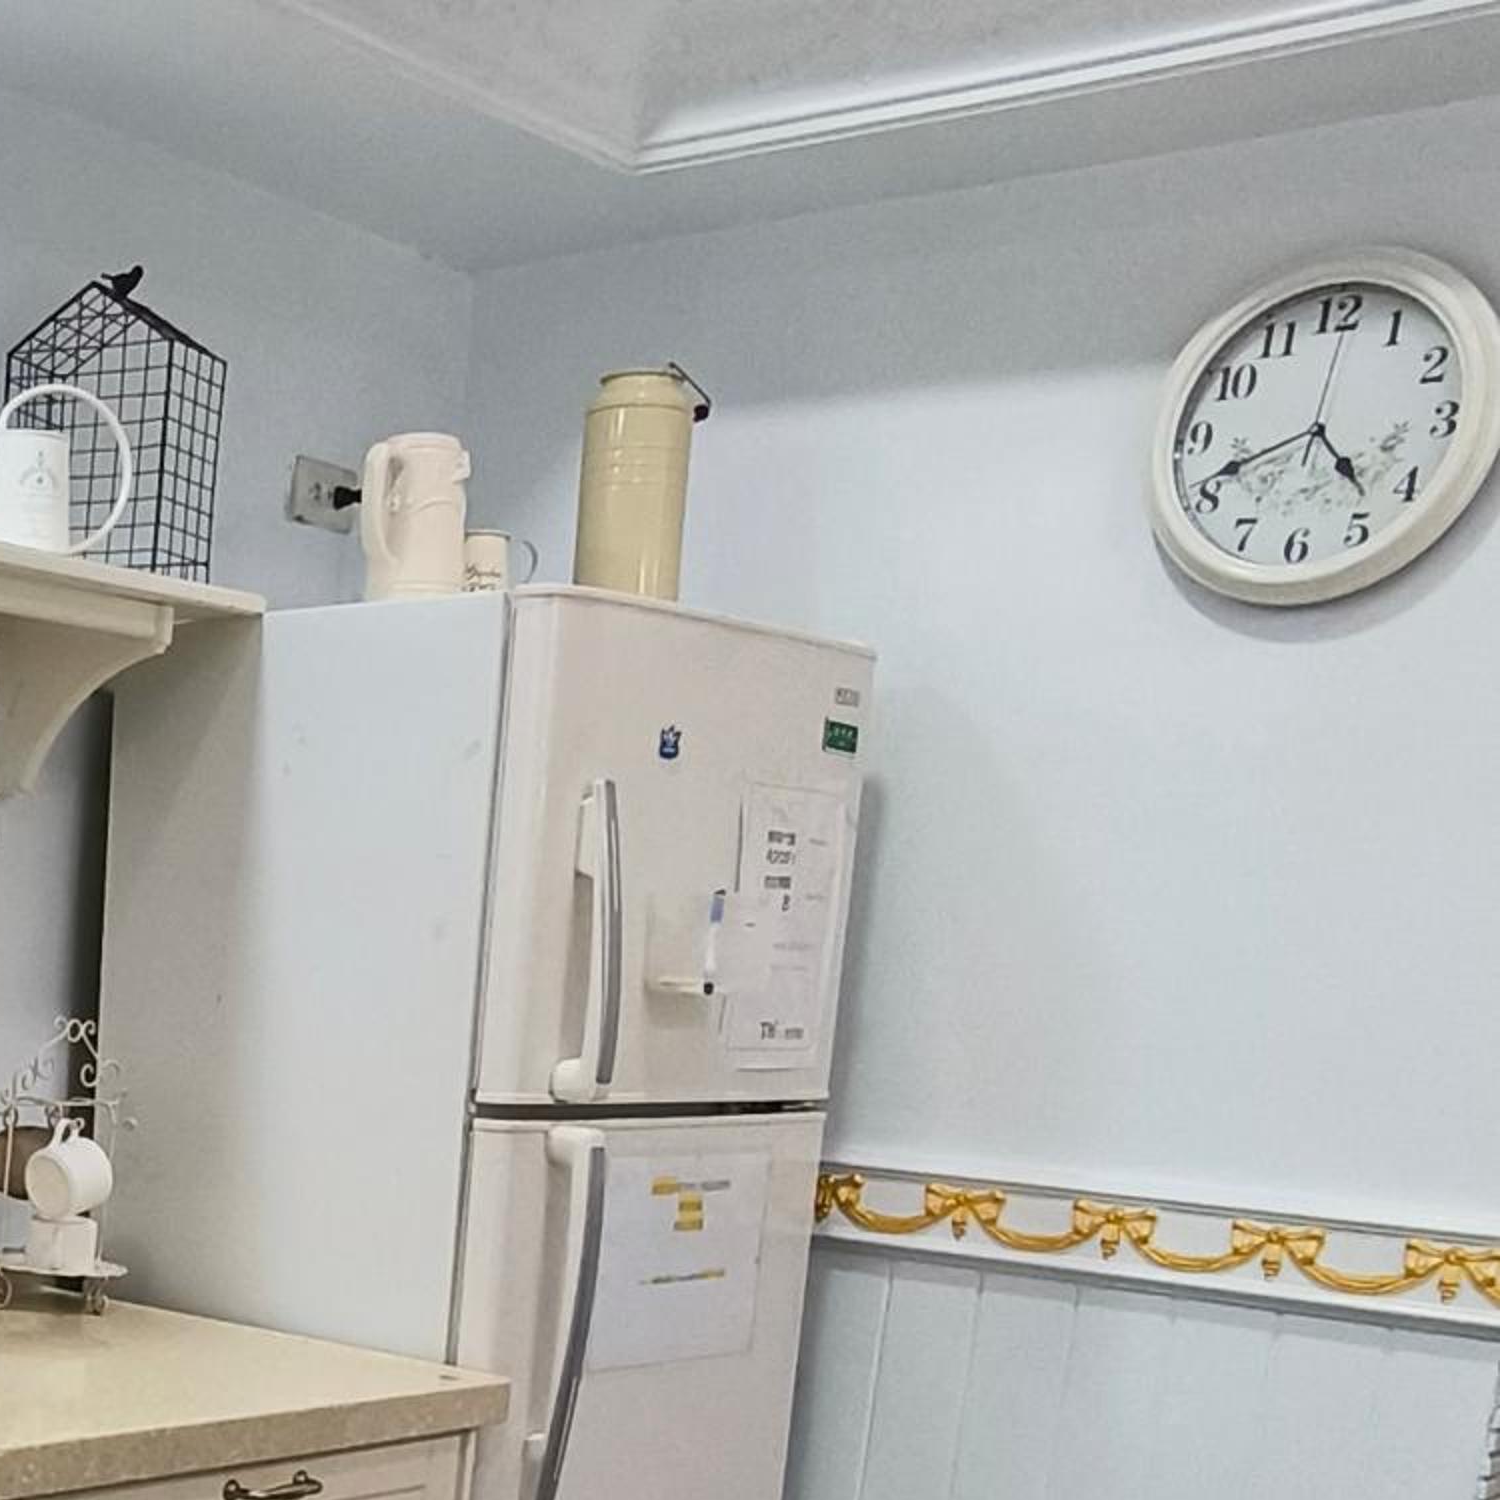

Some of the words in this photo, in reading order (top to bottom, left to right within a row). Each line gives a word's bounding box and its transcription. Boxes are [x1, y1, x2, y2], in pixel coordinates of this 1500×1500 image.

[1314, 295, 1363, 334] 12
[1385, 309, 1403, 347] 1
[1259, 321, 1297, 359] 11
[1214, 363, 1258, 402] 10
[1420, 346, 1450, 384] 2
[1430, 400, 1460, 438] 3
[1187, 421, 1213, 455] 9
[1195, 480, 1222, 513] 8
[1394, 466, 1419, 502] 4
[1235, 518, 1258, 552] 7
[1284, 528, 1310, 563] 6
[1343, 512, 1370, 546] 5
